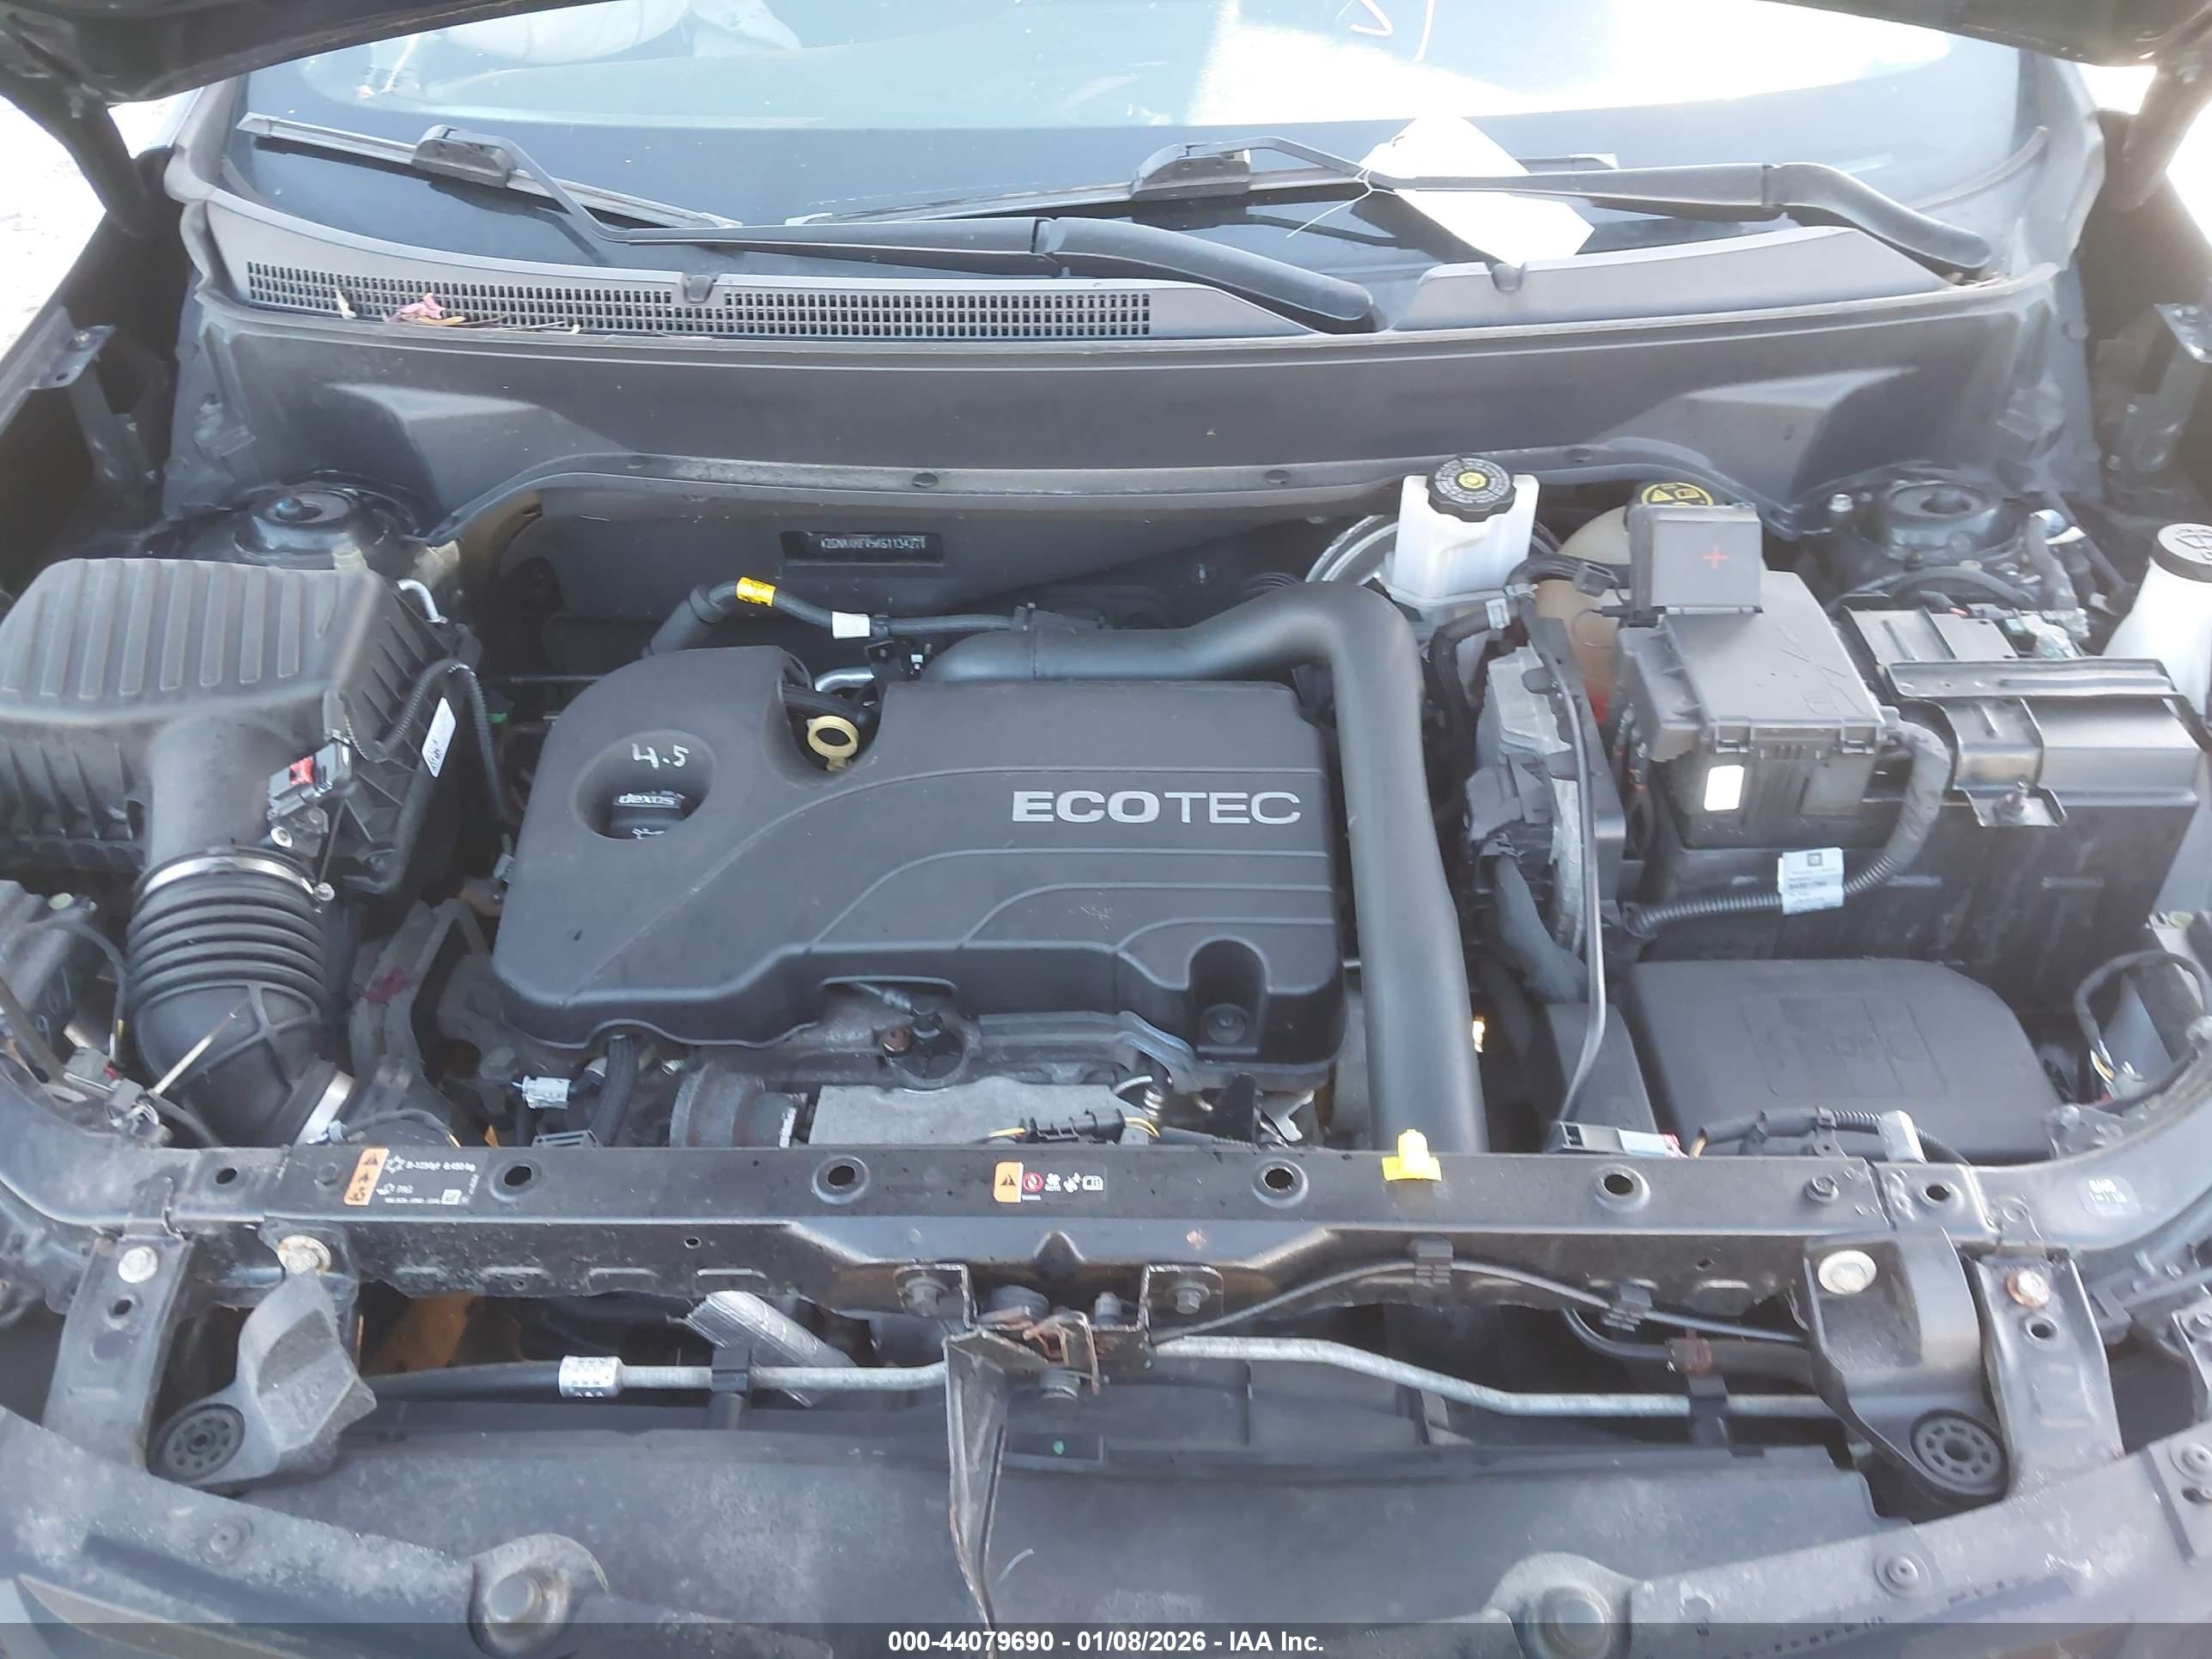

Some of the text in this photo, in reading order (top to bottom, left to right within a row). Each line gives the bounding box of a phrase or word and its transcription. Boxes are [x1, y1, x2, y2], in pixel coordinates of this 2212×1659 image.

[631, 742, 690, 769] 4.5
[618, 793, 676, 805] dexos
[1012, 790, 1302, 824] ECOTEC
